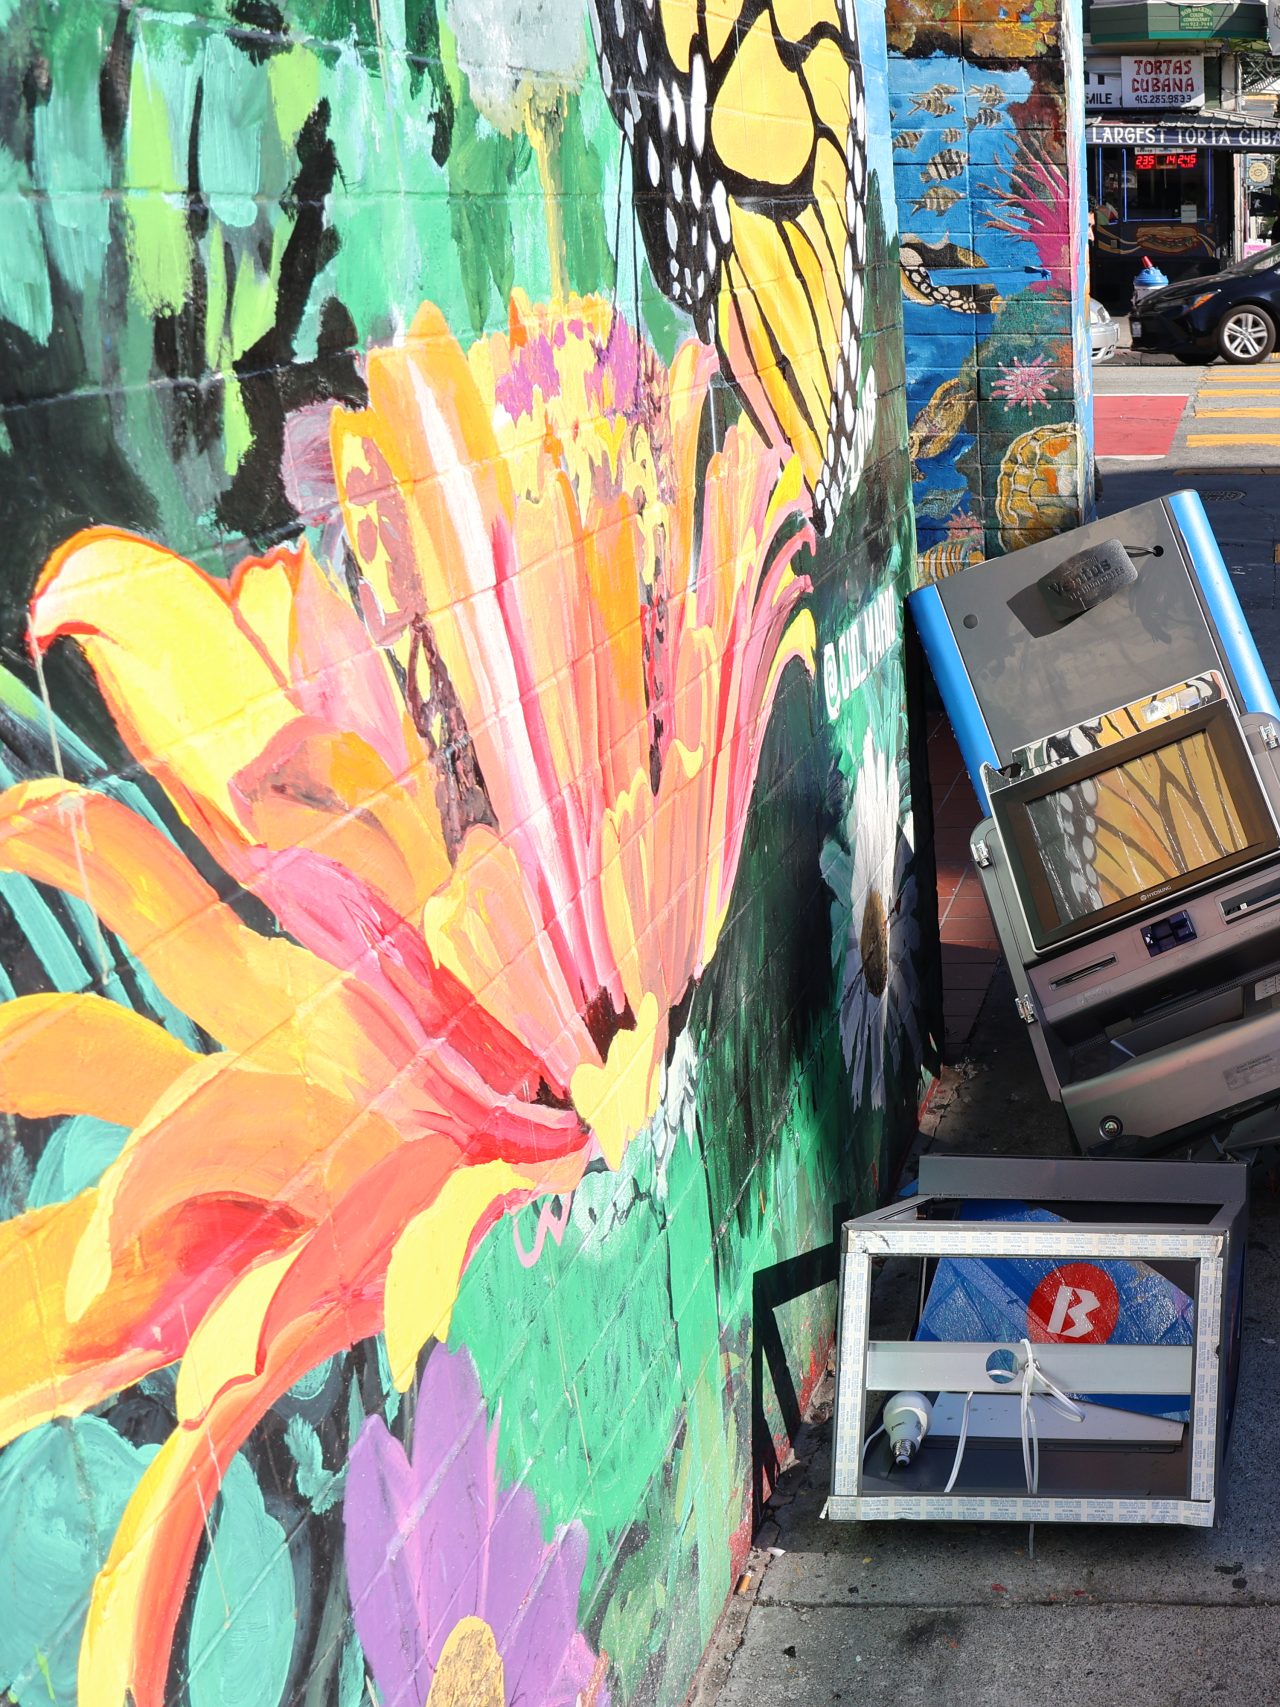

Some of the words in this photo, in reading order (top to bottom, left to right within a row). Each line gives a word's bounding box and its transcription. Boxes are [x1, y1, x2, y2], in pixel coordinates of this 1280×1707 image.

[1134, 59, 1192, 76] TORTAS
[1131, 77, 1195, 93] CUBANA
[1092, 126, 1168, 144] LARGEST
[1175, 127, 1231, 144] TORTA
[1135, 155, 1155, 165] 235
[1166, 155, 1176, 164] 14
[1177, 154, 1197, 164] 245
[1047, 1285, 1101, 1338] B
